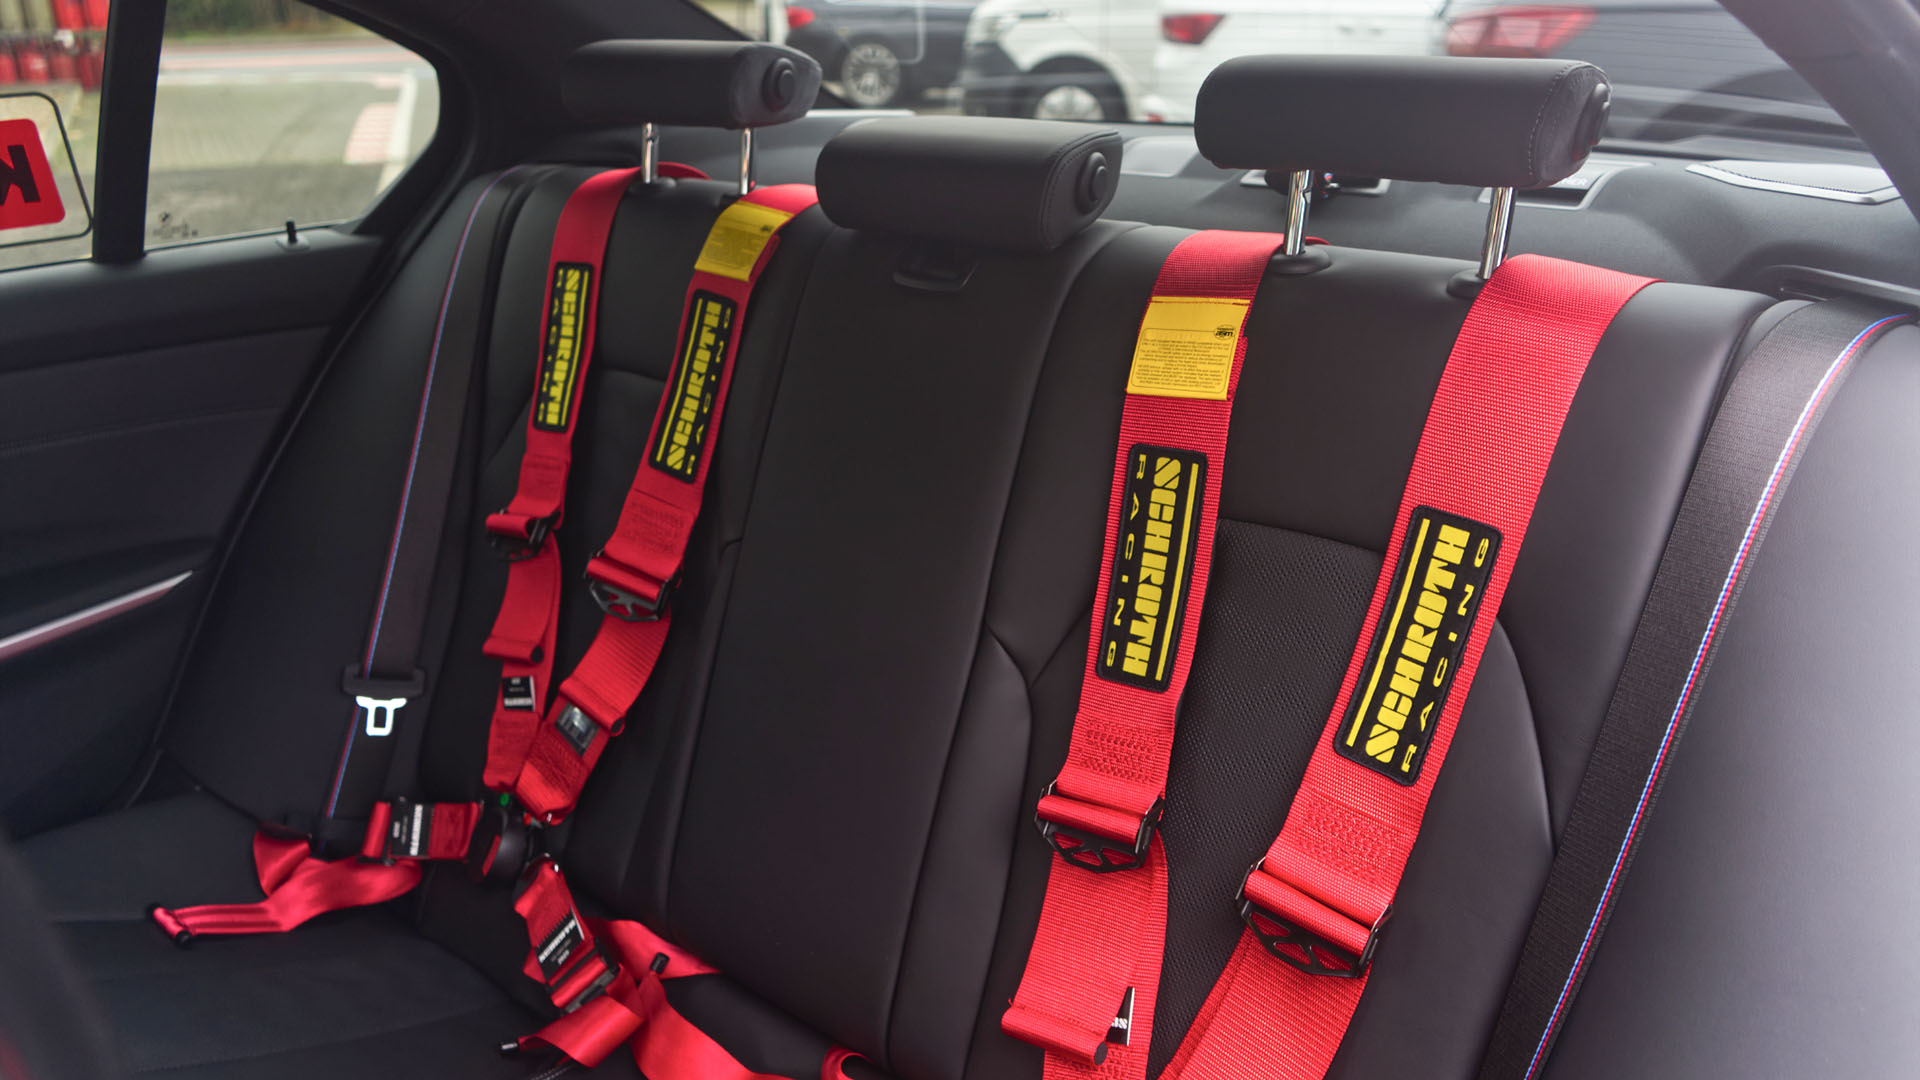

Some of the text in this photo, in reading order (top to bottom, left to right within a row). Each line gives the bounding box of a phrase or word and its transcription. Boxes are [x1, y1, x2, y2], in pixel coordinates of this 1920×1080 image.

[545, 268, 581, 426] SCHROTH
[666, 300, 722, 471] SCHROTH
[1105, 453, 1147, 668] RACING
[1121, 456, 1182, 678] SCHROTH
[1364, 523, 1471, 764] SCHROTH
[1400, 537, 1490, 774] RACING
